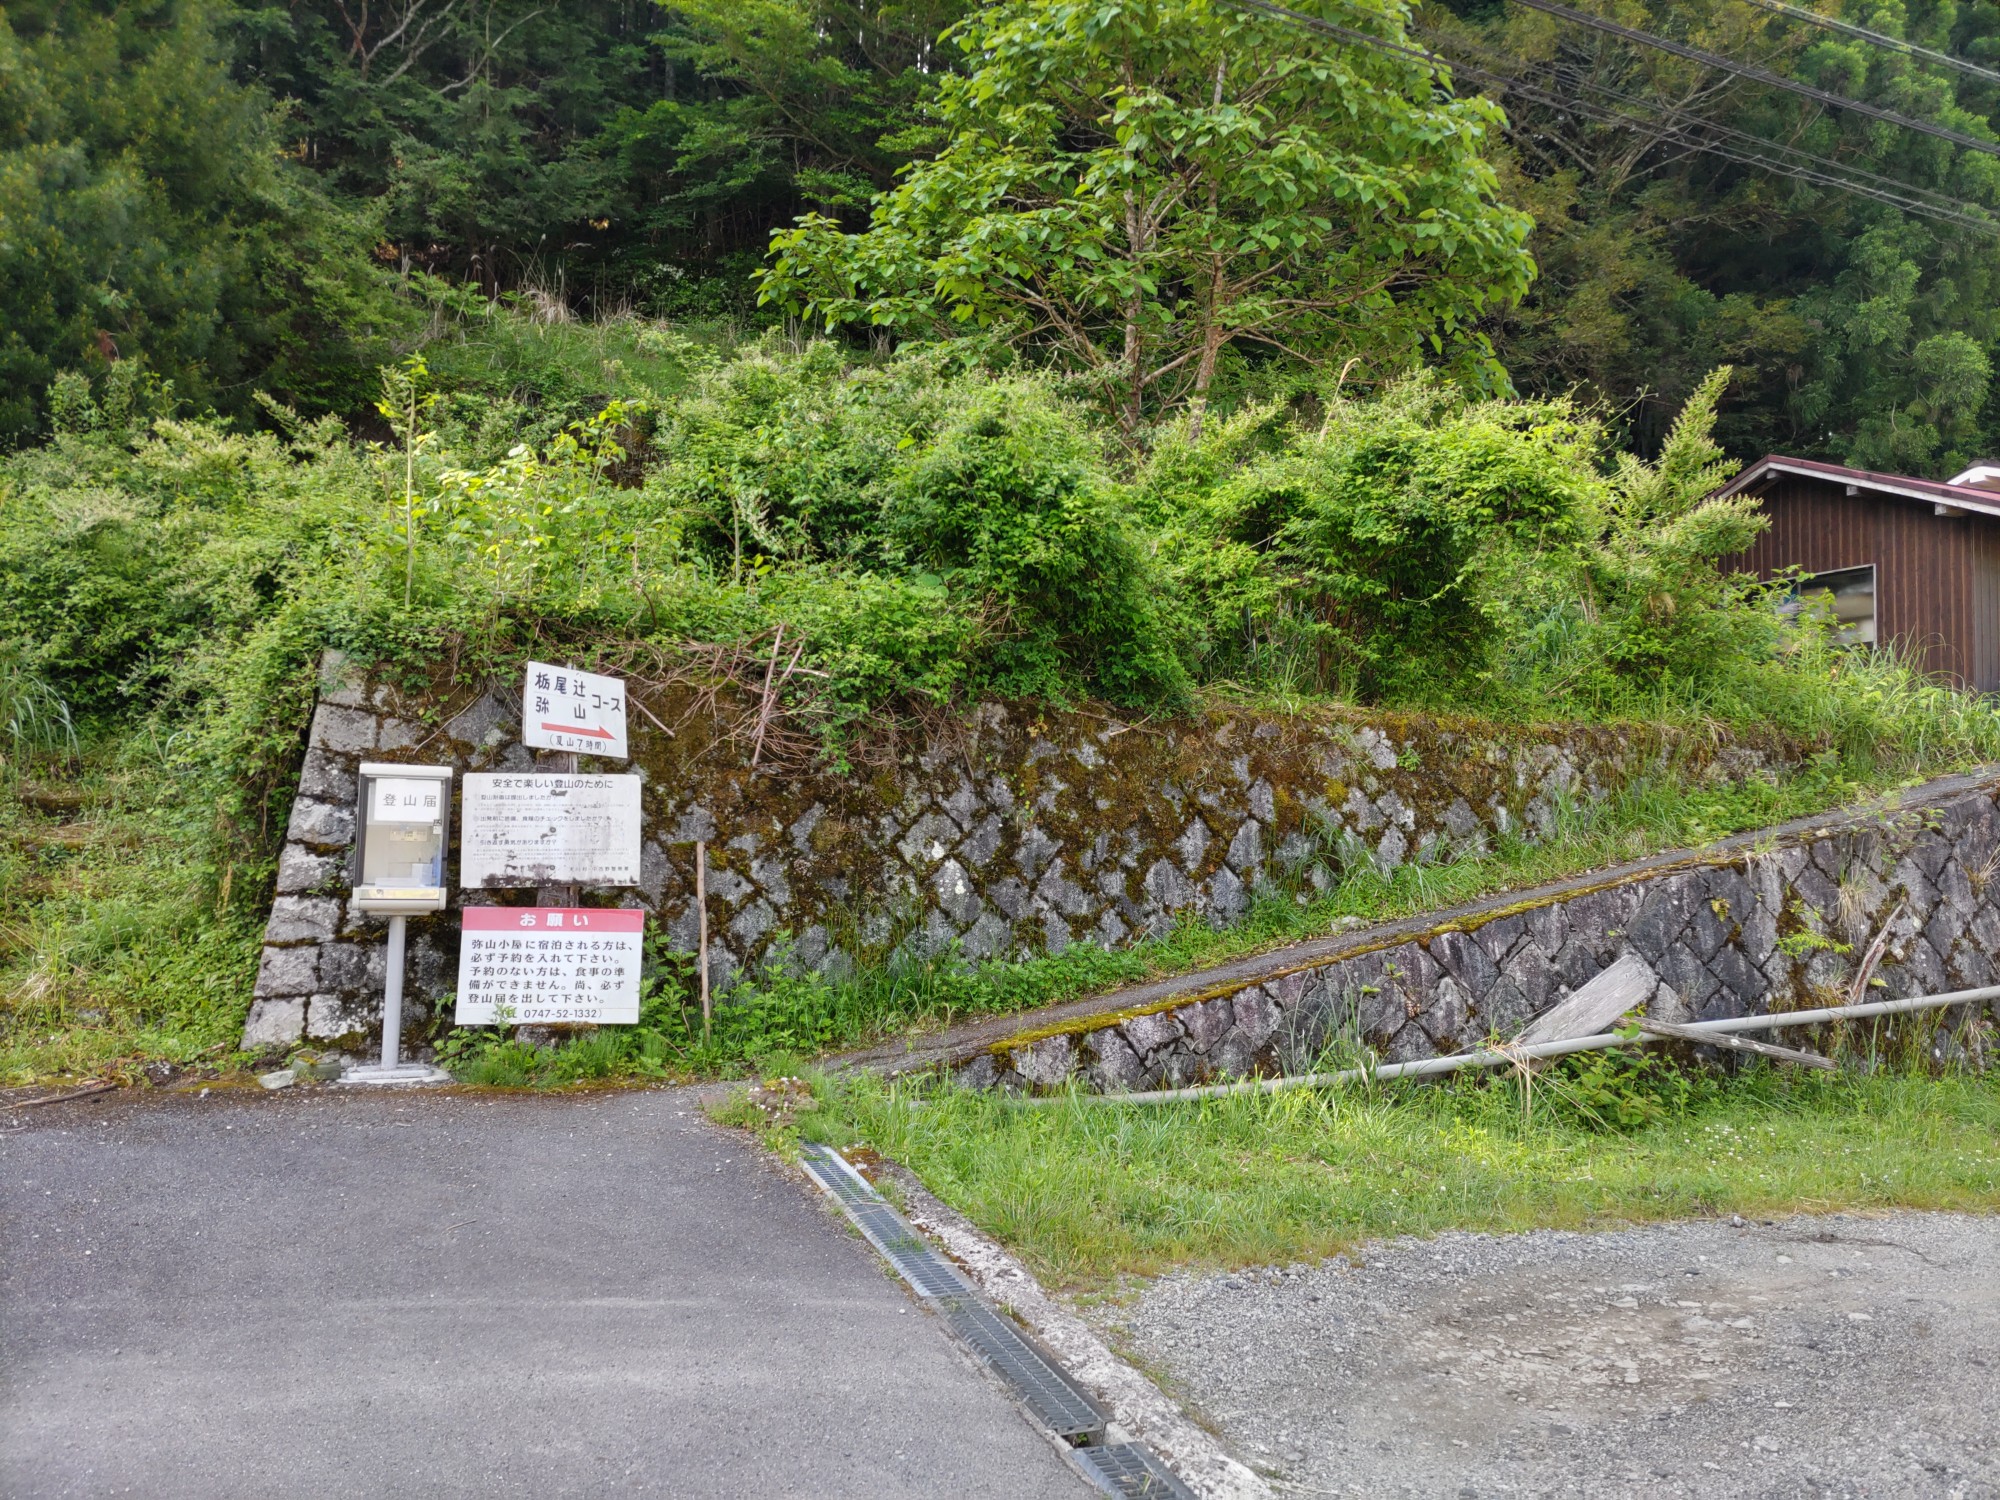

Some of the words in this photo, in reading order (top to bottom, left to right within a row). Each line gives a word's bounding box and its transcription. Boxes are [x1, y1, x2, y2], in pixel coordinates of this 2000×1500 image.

[535, 672, 586, 698] 栃尾辻
[535, 696, 586, 720] 弥山
[592, 694, 621, 712] コース
[492, 778, 614, 789] 安全で楽しい登山のために
[383, 793, 437, 808] 登山届
[519, 912, 590, 927] お願い
[471, 939, 634, 951] 弥山小屋に宿泊される方は、
[470, 953, 621, 964] 必ず予約を入れて下さい。
[469, 966, 625, 977] 予約のない方は、食事の準
[467, 993, 606, 1004] 登山届を出して下さい。
